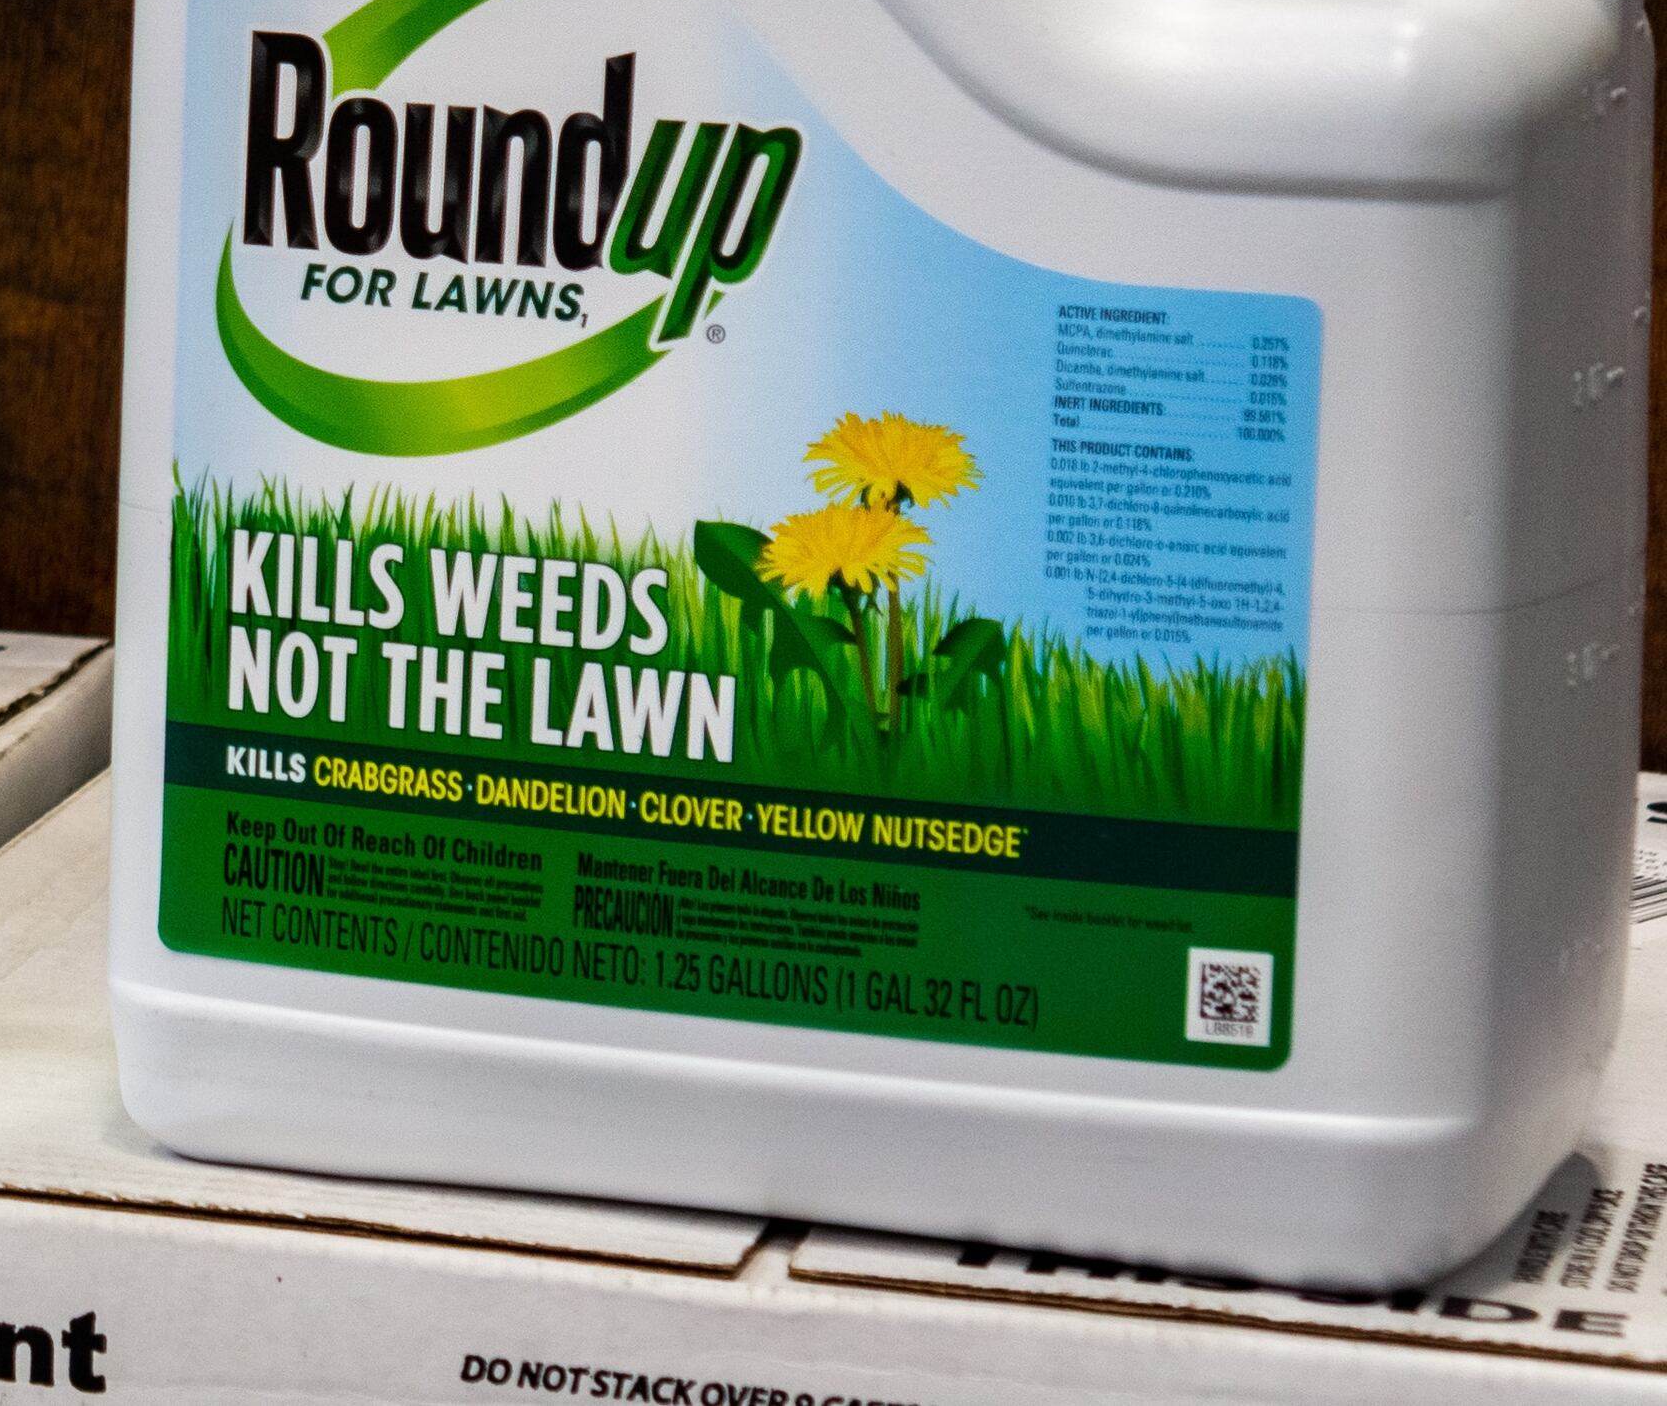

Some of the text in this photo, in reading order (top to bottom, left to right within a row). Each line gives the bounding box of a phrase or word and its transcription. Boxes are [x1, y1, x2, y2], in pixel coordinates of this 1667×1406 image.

[244, 30, 802, 343] Roundup
[301, 263, 394, 307] FOR
[232, 529, 669, 656] KILLS WEEDS
[228, 625, 737, 763] NOT THE LAWN
[226, 745, 306, 782] KILLS
[314, 755, 463, 802] CRABGRASS
[476, 775, 626, 820] DANDELION
[639, 792, 743, 832] CLOVER
[756, 803, 865, 843] YELLOW
[226, 811, 543, 872] Keep Out Of Reach Of Children
[224, 843, 325, 896] CAUTION
[222, 897, 267, 938] NET
[272, 904, 398, 957] CONTENTS
[420, 921, 564, 976] CONTENIDO
[573, 941, 646, 985] NETO:
[655, 951, 701, 992] 1.25
[708, 954, 827, 1006] GALLONS
[836, 971, 856, 1013] (1
[867, 973, 917, 1016] GAL
[924, 978, 952, 1017] 32
[961, 981, 987, 1022] FL
[997, 985, 1039, 1031] OZ)
[460, 1355, 512, 1385] DO
[518, 1361, 590, 1394] NOT
[590, 1370, 697, 1406] STACK
